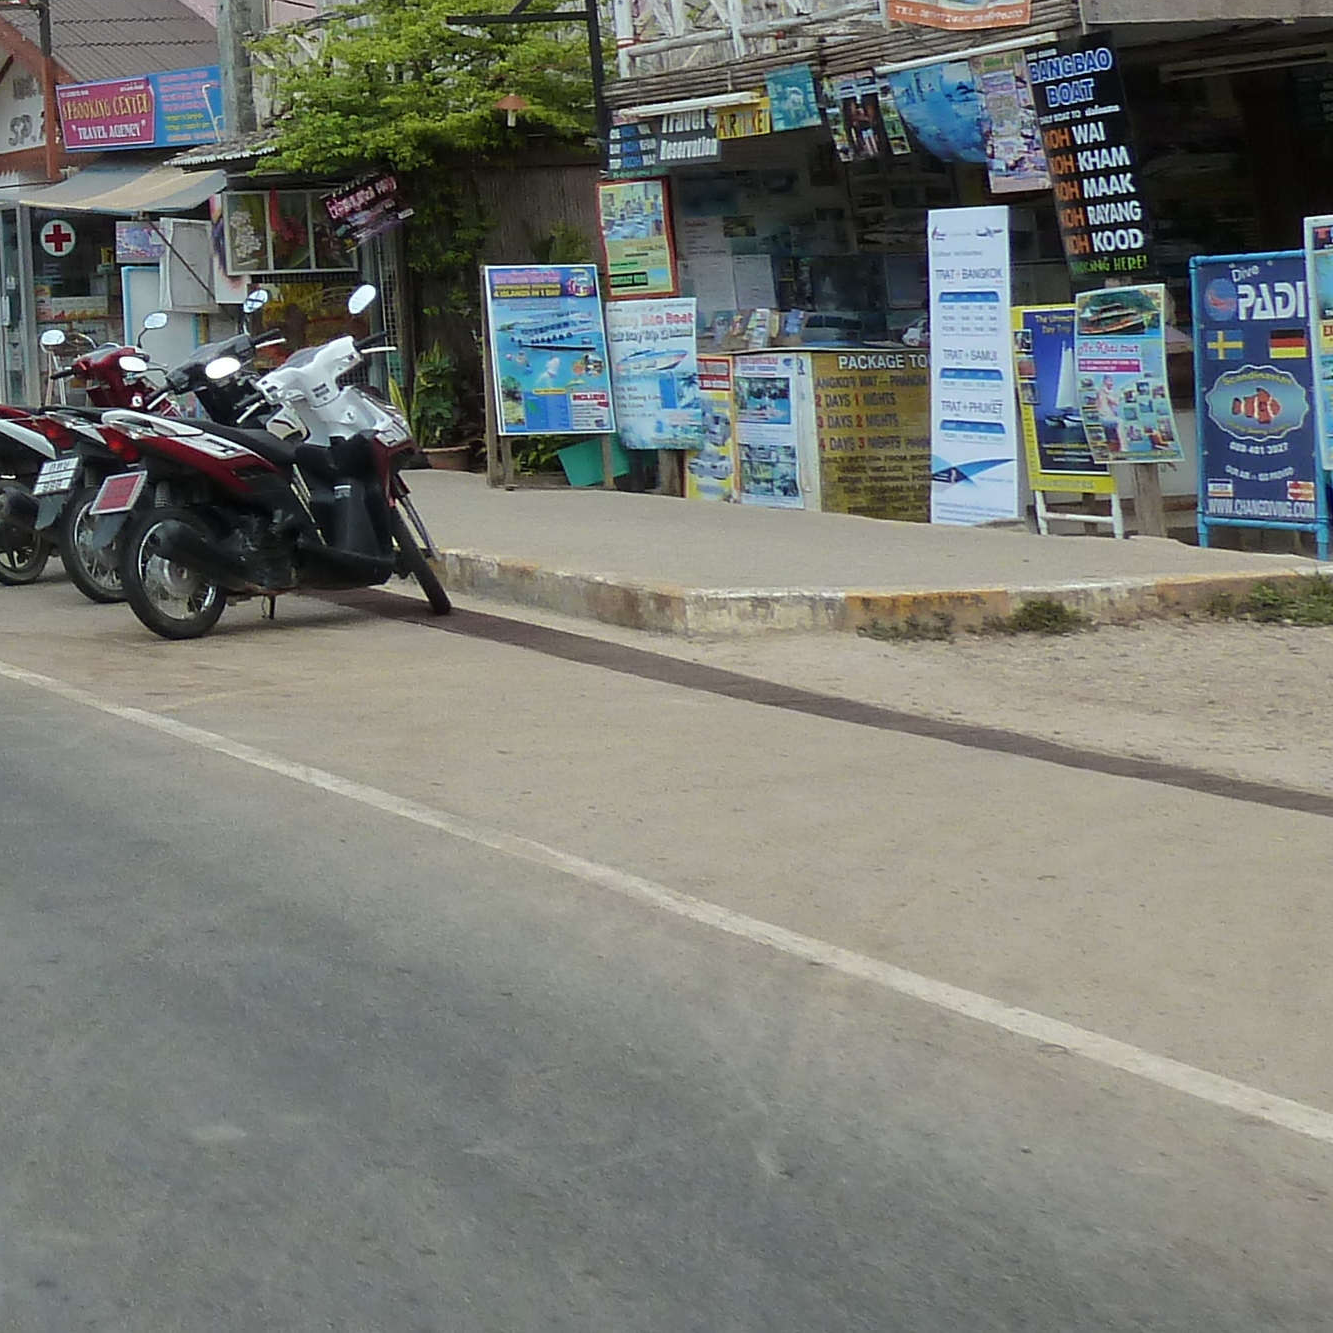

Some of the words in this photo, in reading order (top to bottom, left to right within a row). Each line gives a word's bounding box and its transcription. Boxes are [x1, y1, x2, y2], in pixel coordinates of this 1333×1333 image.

[1027, 47, 1113, 84] BANGBAO
[1045, 77, 1095, 108] BOAT
[113, 93, 152, 116] CENTER
[1071, 121, 1106, 145] WAI
[660, 136, 717, 160] Reservation
[1077, 145, 1131, 172] KHAM
[1083, 172, 1136, 199] MAAK
[1087, 200, 1142, 226] RAYANG
[1091, 228, 1145, 253] KOOD
[935, 269, 955, 280] TRAT
[962, 268, 1003, 279] BANGKOK
[1232, 265, 1260, 282] Dive
[1237, 281, 1306, 320] PADI
[838, 354, 905, 370] PACKAGE
[943, 349, 964, 361] TRAT
[814, 394, 822, 408] 2
[824, 393, 851, 407] DAYS
[863, 392, 896, 405] NIGHTS
[941, 400, 962, 412] TRAT
[969, 401, 1003, 414] PHUKET
[817, 415, 824, 428] 3
[827, 414, 853, 428] DAYS
[856, 414, 863, 428] 2
[866, 413, 899, 427] NIGHTS
[829, 437, 855, 451] DAYS
[858, 436, 865, 449] 3
